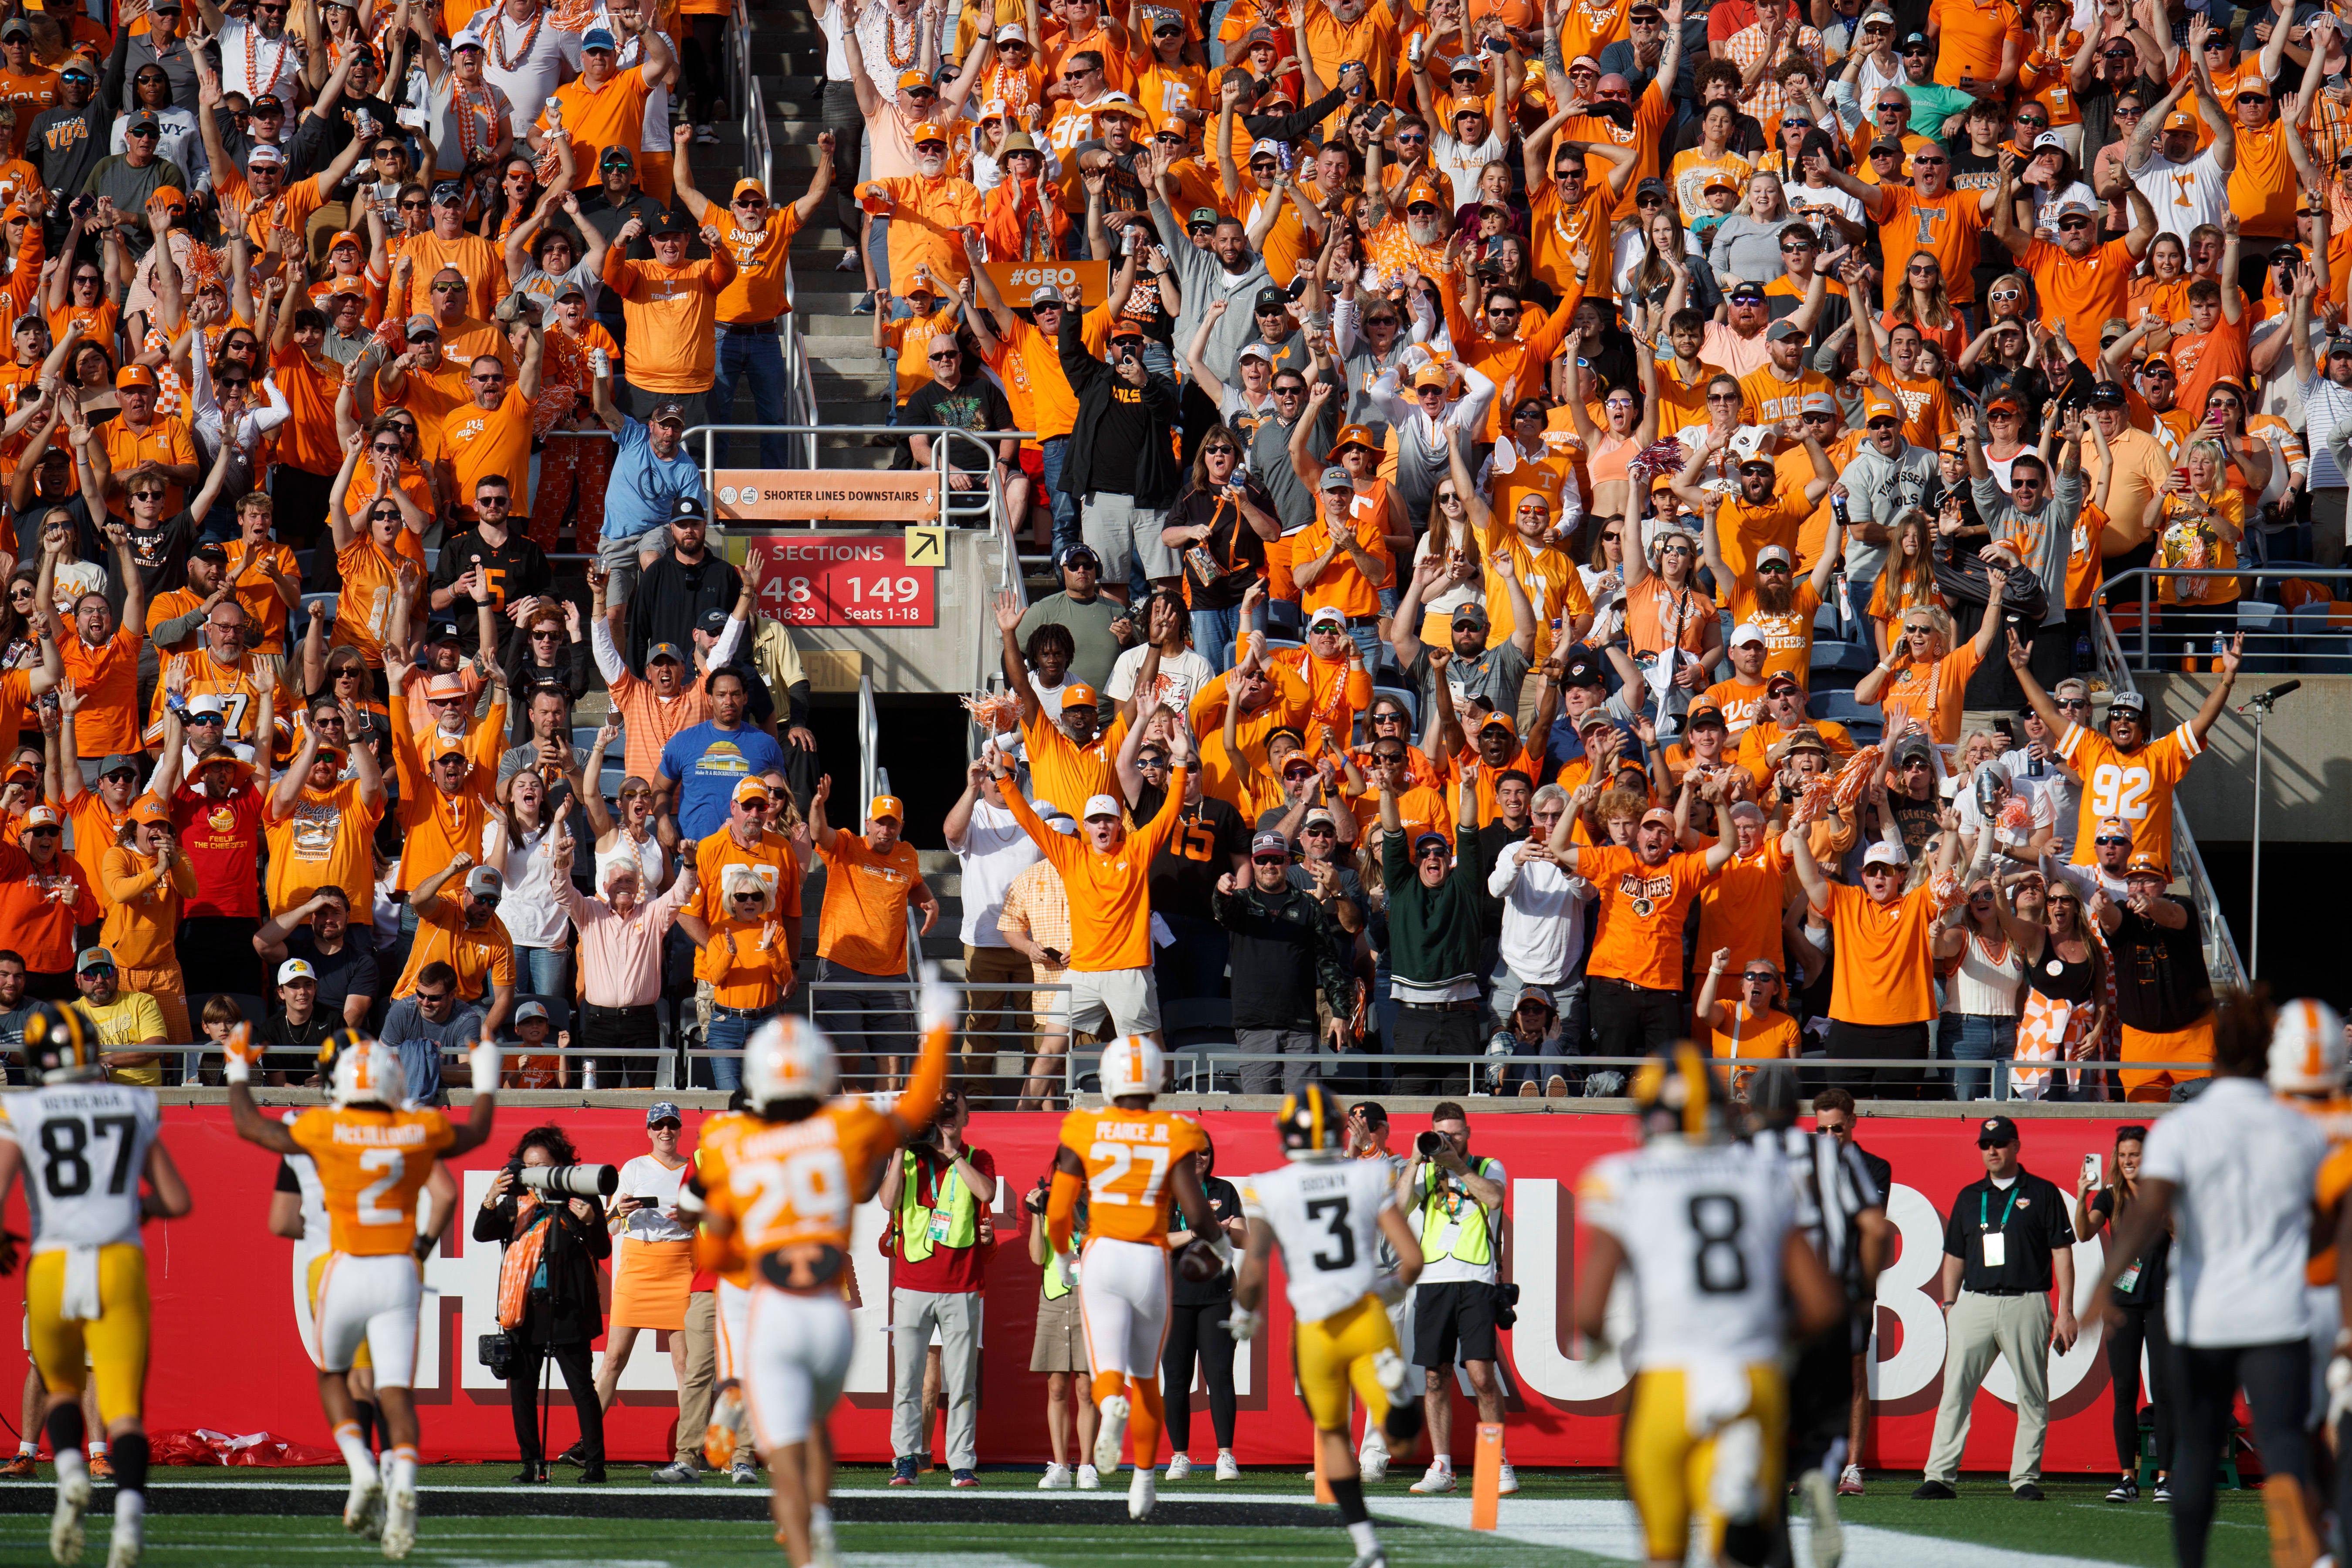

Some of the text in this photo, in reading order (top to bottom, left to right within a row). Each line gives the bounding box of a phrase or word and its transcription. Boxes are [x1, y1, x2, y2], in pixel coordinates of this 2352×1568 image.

[46, 124, 88, 151] VOS
[1713, 174, 1726, 184] T
[1953, 172, 2001, 190] TENNESS
[2171, 173, 2196, 207] T
[1910, 206, 1946, 244] T
[664, 280, 675, 294] T
[1010, 268, 1075, 286] #GBO
[651, 292, 687, 301] TENNESSEE
[444, 345, 458, 356] T
[129, 369, 139, 378] T
[1762, 396, 1803, 420] TENNES
[1540, 431, 1584, 451] TENNESSEE
[1538, 471, 1557, 489] T
[1878, 471, 1926, 497] TENNESSEE
[764, 491, 919, 501] SHORTER LINES DOWNSTAIRS
[1890, 493, 1919, 508] VOLS
[772, 545, 884, 562] SECTIONS
[761, 577, 811, 602] 48
[847, 577, 919, 603] 149
[777, 609, 816, 620] 16-29
[844, 608, 919, 620] Seats 1-18
[1765, 637, 1806, 648] UNTEERS
[808, 655, 847, 687] EXIT
[1722, 698, 1756, 722] Vo
[2092, 764, 2150, 819] 92
[1171, 817, 1215, 862] 15
[95, 1014, 131, 1038] TRUS
[1096, 1121, 1169, 1142] PEARCE JR.
[40, 1115, 137, 1198] 87
[1090, 1141, 1170, 1206] 27
[357, 1148, 403, 1225] 2
[1307, 1197, 1355, 1271] 3
[1689, 1194, 1749, 1294] 8
